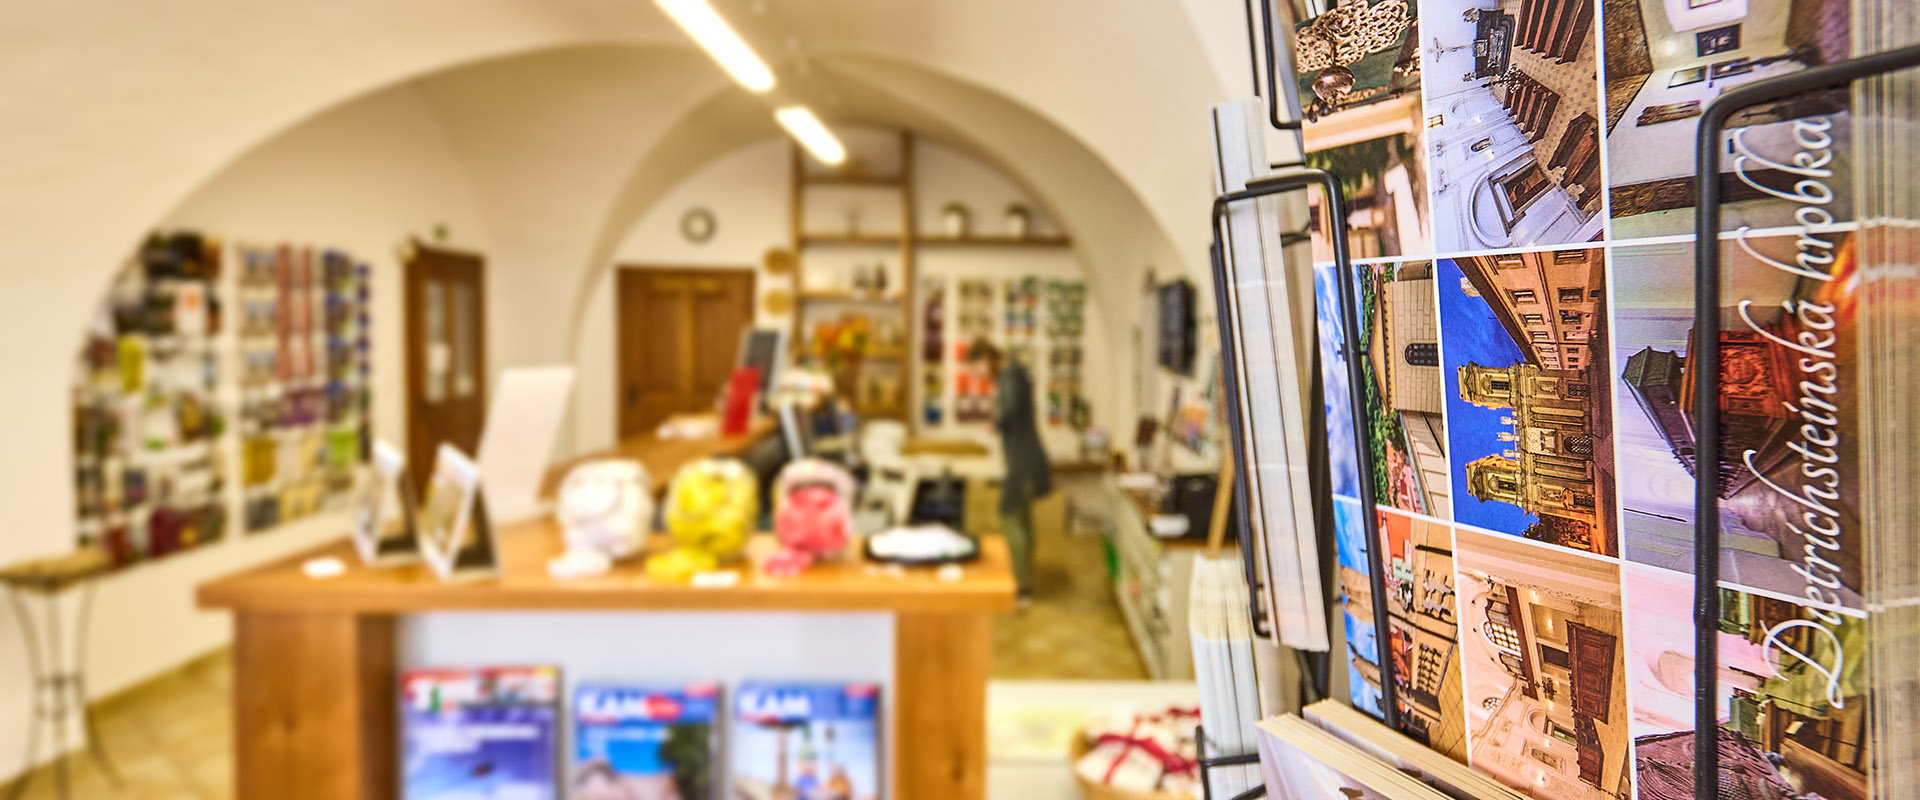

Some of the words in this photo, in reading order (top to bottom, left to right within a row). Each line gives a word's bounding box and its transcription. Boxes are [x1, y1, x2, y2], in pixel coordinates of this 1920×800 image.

[1734, 117, 1834, 281] hrobka
[1738, 299, 1844, 709] Dietrichsteinská
[738, 690, 810, 717] KAM
